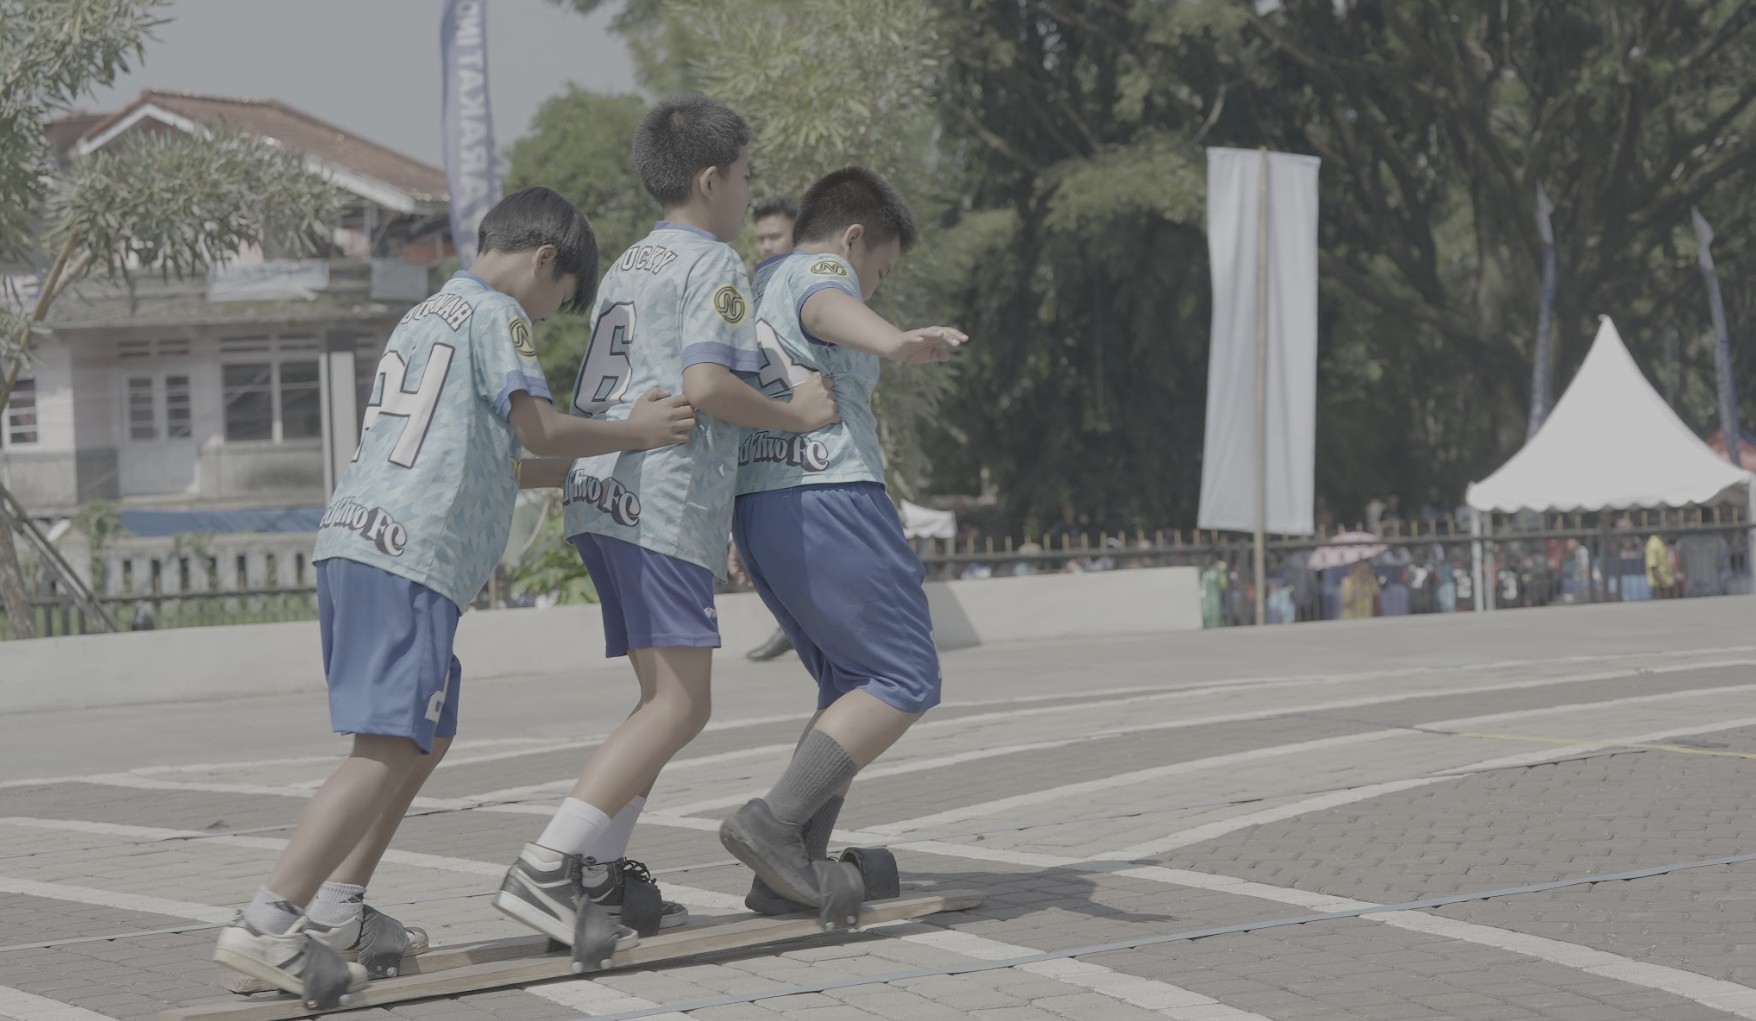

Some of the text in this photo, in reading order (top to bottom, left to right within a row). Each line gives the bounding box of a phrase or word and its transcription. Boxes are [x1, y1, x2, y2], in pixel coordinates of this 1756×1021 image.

[574, 301, 637, 417] 6
[597, 477, 641, 527] FC
[360, 507, 407, 557] FC
